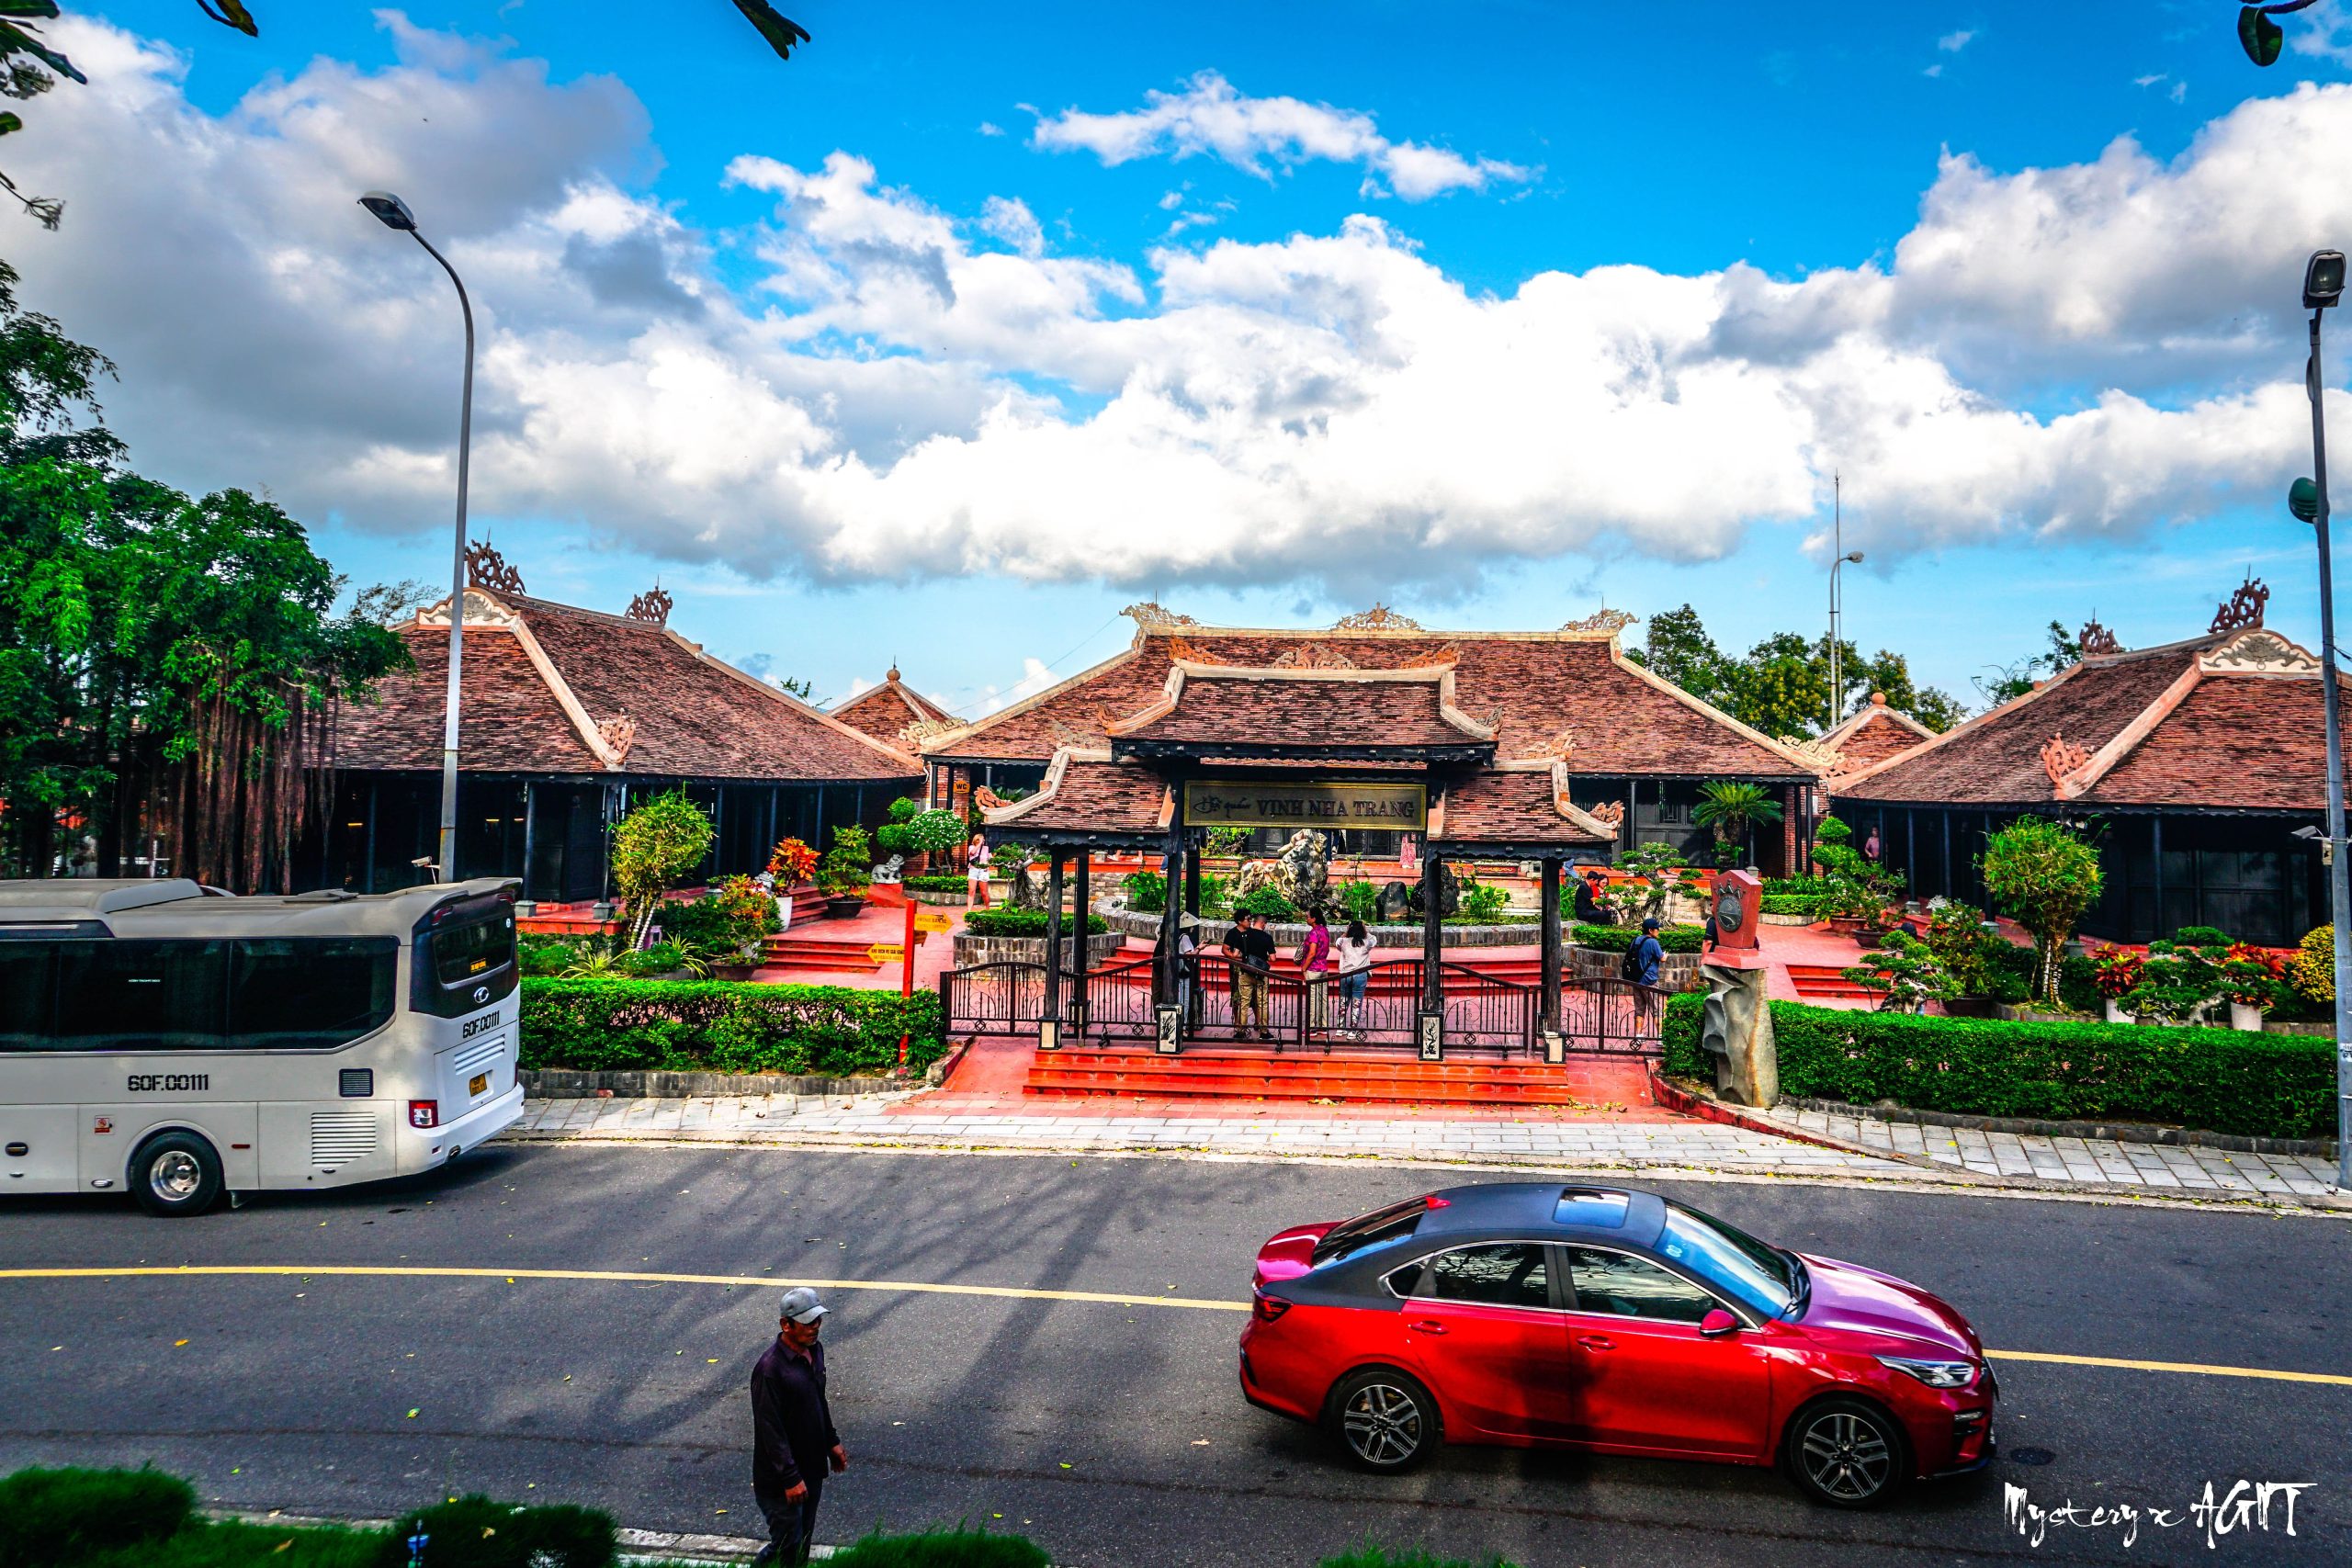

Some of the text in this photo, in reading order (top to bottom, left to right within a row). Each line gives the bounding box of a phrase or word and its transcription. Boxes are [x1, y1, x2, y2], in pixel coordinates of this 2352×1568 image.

[1308, 800, 1349, 817] NHA
[1353, 800, 1414, 818] TRANG
[462, 1010, 500, 1039] 60F.00111
[127, 1074, 209, 1091] 60F.00111
